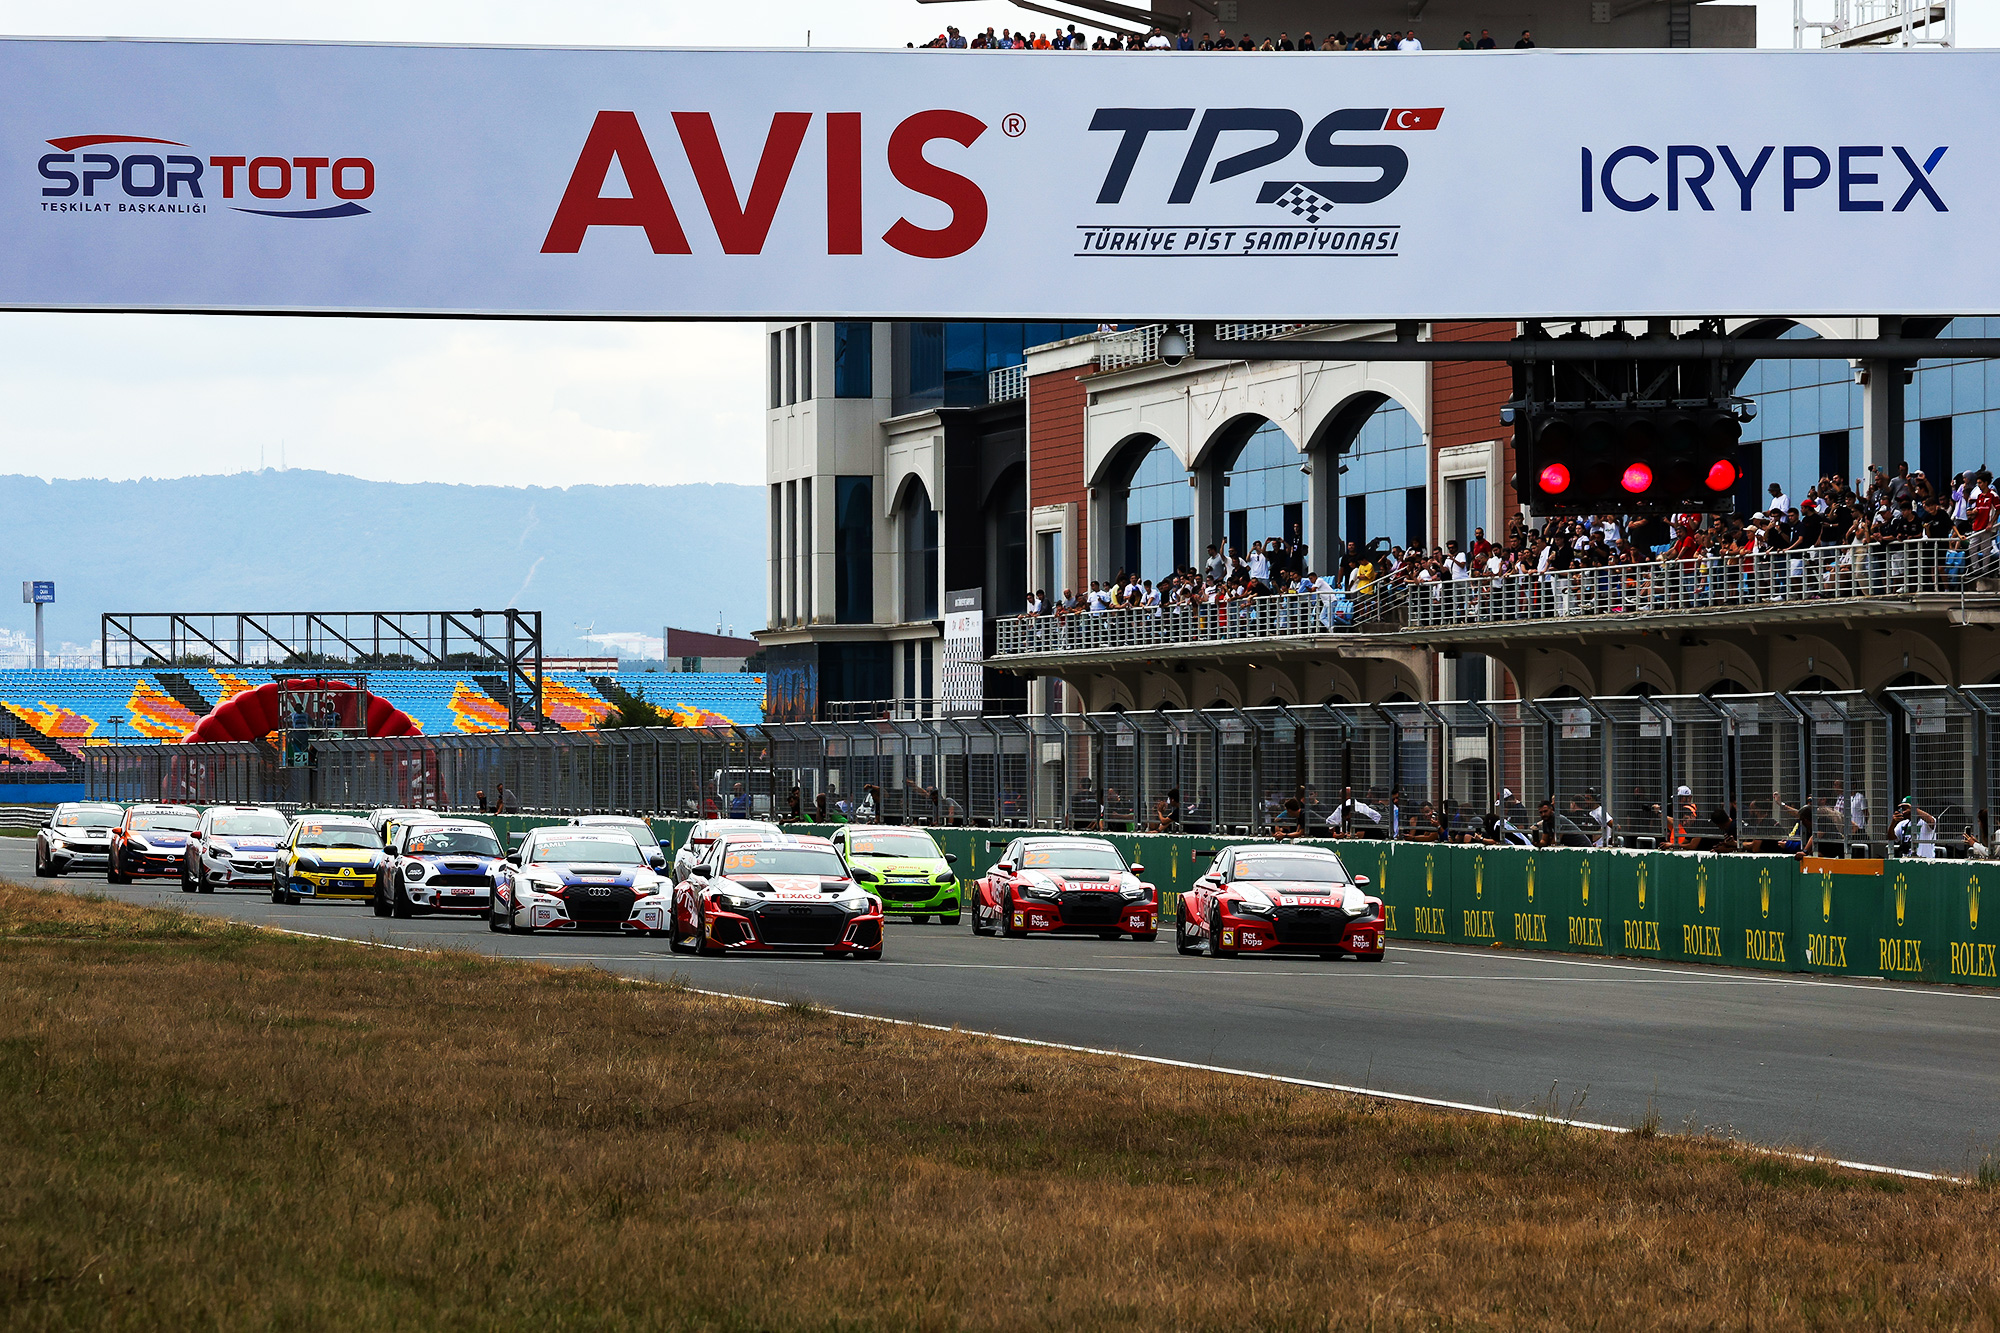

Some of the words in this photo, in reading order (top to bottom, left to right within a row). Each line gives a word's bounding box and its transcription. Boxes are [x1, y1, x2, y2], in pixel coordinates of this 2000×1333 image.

[1088, 108, 1409, 205] TPS
[539, 109, 989, 260] AVIS
[1581, 145, 1950, 213] ICRYPEX
[41, 202, 112, 214] TEŞKİLAT
[118, 202, 207, 215] BAŞKANLIĞI
[1082, 227, 1177, 251] TÜRKİYE
[1185, 227, 1237, 251] PİST
[1243, 227, 1399, 255] ŞAMPİYONASI
[300, 825, 324, 836] 15
[408, 835, 434, 846] AKÇA
[409, 842, 425, 852] 16
[739, 842, 763, 850] AVIS
[800, 843, 823, 851] AVIS
[854, 842, 875, 852] 99
[541, 848, 550, 857] 7
[1024, 852, 1051, 866] 22
[724, 854, 756, 870] 95
[1235, 863, 1250, 877] 5
[774, 892, 822, 900] TEXACO
[1031, 919, 1049, 928] Pops
[1129, 920, 1145, 928] Pops
[1414, 907, 1446, 935] ROLEX
[1463, 910, 1495, 938] ROLEX
[1514, 912, 1547, 942] ROLEX
[1242, 932, 1256, 940] Pet
[1352, 934, 1364, 942] Pet
[1568, 916, 1603, 947] ROLEX
[1624, 920, 1661, 951] ROLEX
[1242, 938, 1263, 947] Pops
[1352, 940, 1370, 949] Pops
[1682, 924, 1722, 957] ROLEX
[1745, 929, 1786, 963] ROLEX
[1808, 933, 1848, 968] ROLEX
[1879, 938, 1923, 972] ROLEX
[1951, 942, 1998, 978] ROLEX
